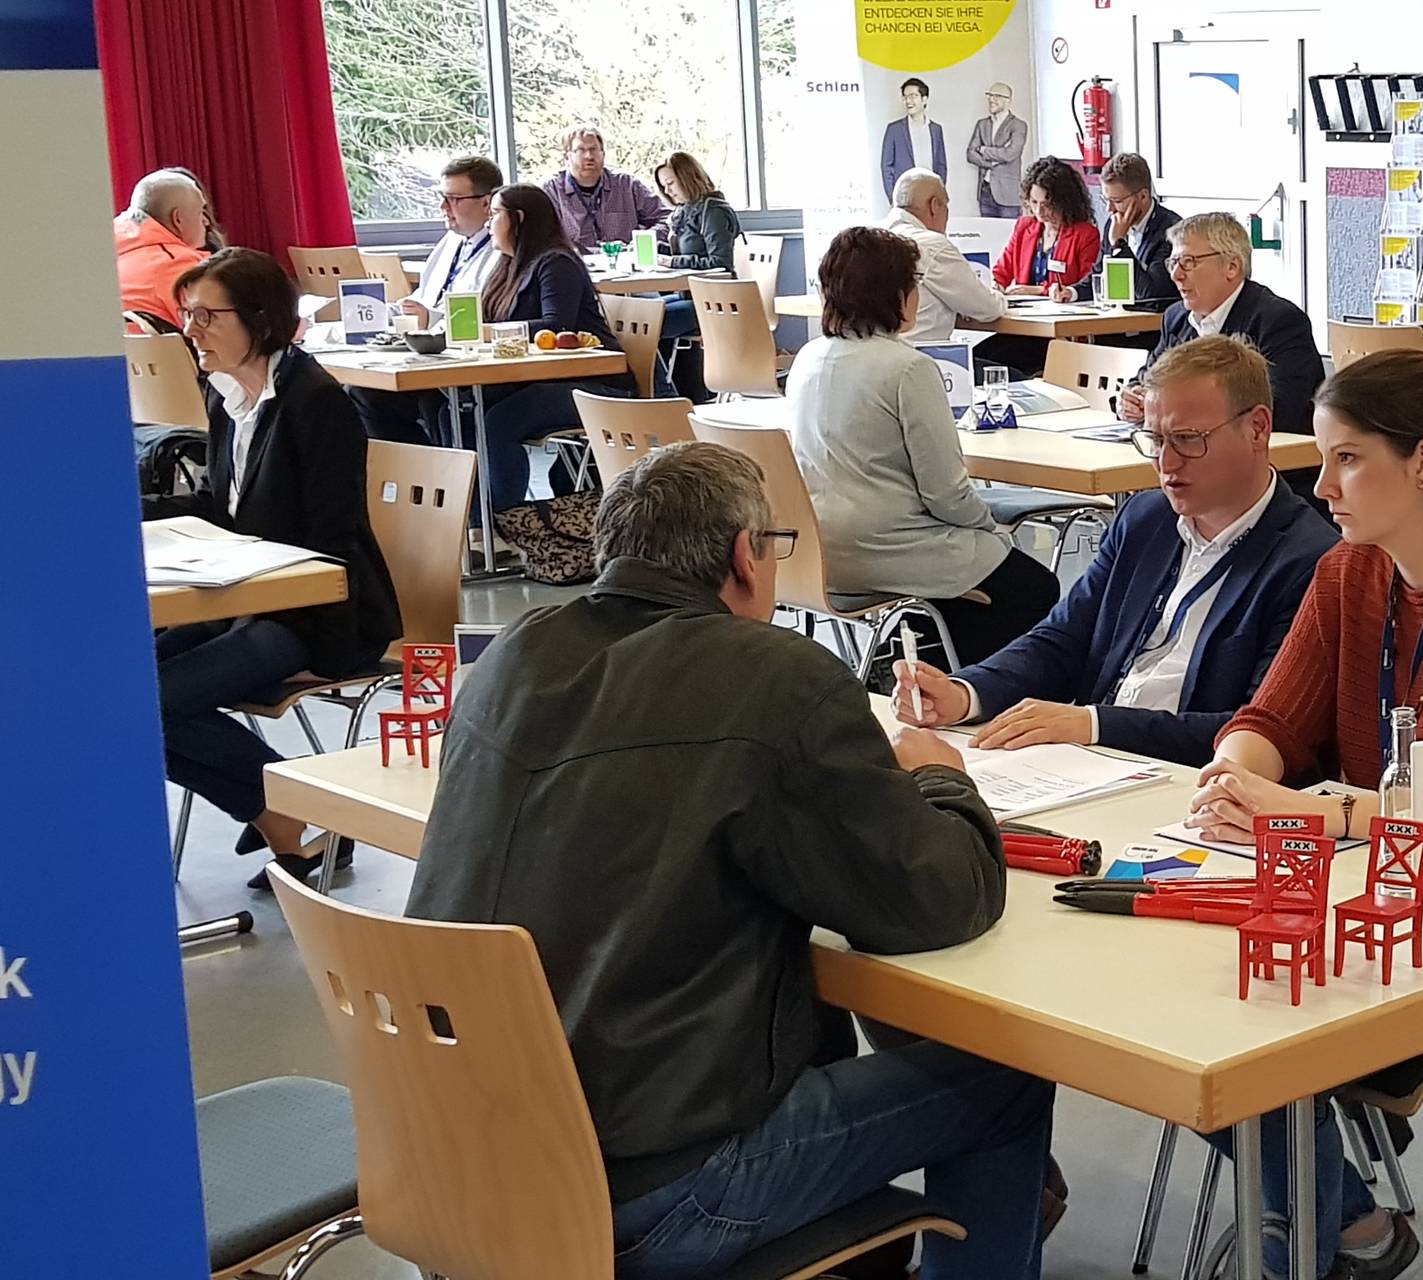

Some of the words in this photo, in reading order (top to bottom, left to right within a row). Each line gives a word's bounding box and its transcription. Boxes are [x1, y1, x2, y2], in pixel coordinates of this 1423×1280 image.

[864, 8, 933, 18] ENTDECKEN
[936, 7, 954, 18] SIE
[957, 7, 984, 18] IHRE
[865, 23, 921, 33] CHANCEN
[925, 22, 942, 33] BEI
[946, 22, 983, 33] VIEGA.
[358, 309, 374, 321] 16
